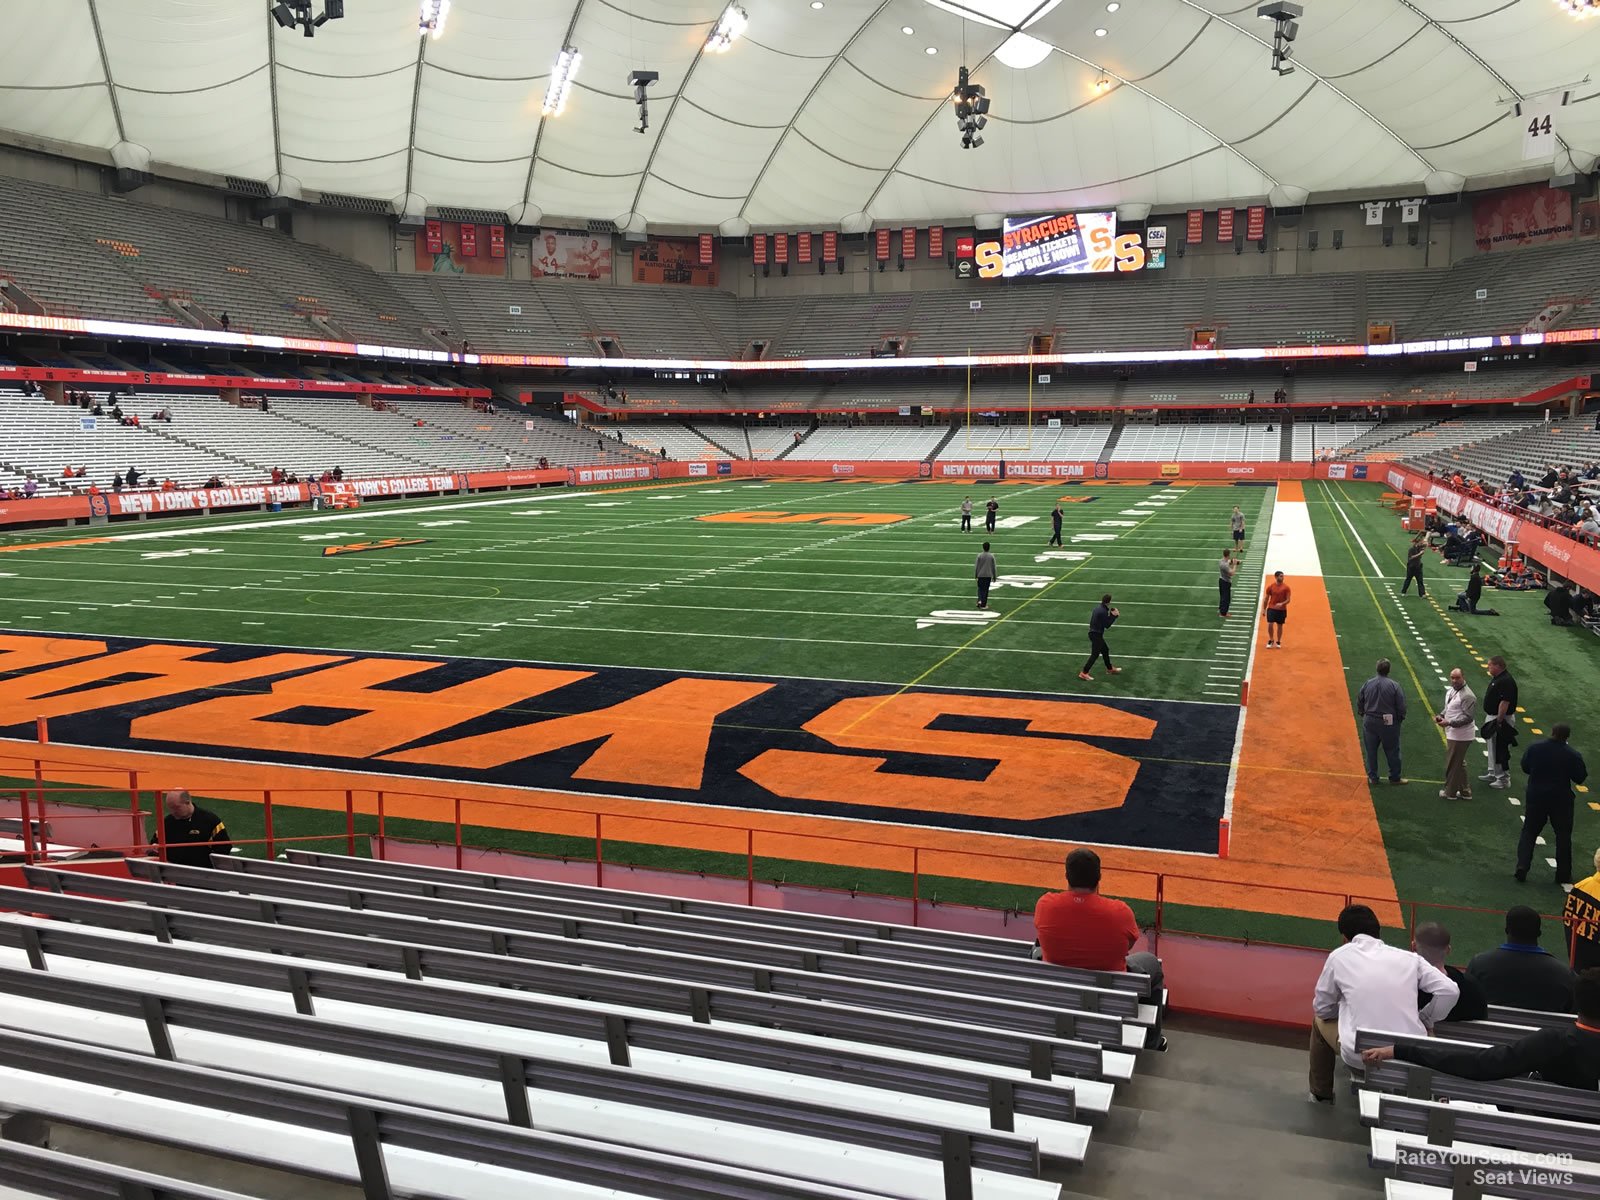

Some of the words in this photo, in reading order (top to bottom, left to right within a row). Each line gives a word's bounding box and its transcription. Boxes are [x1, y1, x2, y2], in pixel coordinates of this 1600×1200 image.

[1528, 115, 1552, 137] 44
[1372, 210, 1378, 218] 5
[1408, 208, 1414, 216] 9
[1004, 214, 1077, 248] SYRACUSE
[1493, 232, 1526, 243] NATIONAL
[1528, 224, 1573, 237] CHAMPIONS
[1006, 246, 1040, 264] SEASON
[1040, 234, 1078, 253] TICKETS
[1025, 253, 1051, 270] SALE
[1051, 244, 1080, 261] NOW!
[1115, 233, 1145, 272] S
[1545, 329, 1595, 343] SYRACUSE
[480, 355, 525, 365] SYRACUSE
[144, 374, 151, 384] S
[580, 470, 593, 482] NEW
[592, 469, 613, 481] YORK'S
[614, 468, 636, 480] COLLEGE
[636, 466, 650, 478] TEAM
[943, 465, 965, 476] NEW
[1006, 464, 1053, 476] COLLEGE
[1055, 464, 1084, 476] TEAM
[352, 480, 389, 496] YORK'S
[390, 477, 429, 493] COLLEGE
[429, 475, 453, 490] TEAM
[92, 496, 108, 516] S
[118, 494, 152, 513] NEW
[156, 492, 208, 510] YORK'S
[212, 488, 265, 507] COLLEGE
[266, 485, 300, 502] TEAM
[915, 610, 1001, 629] 10
